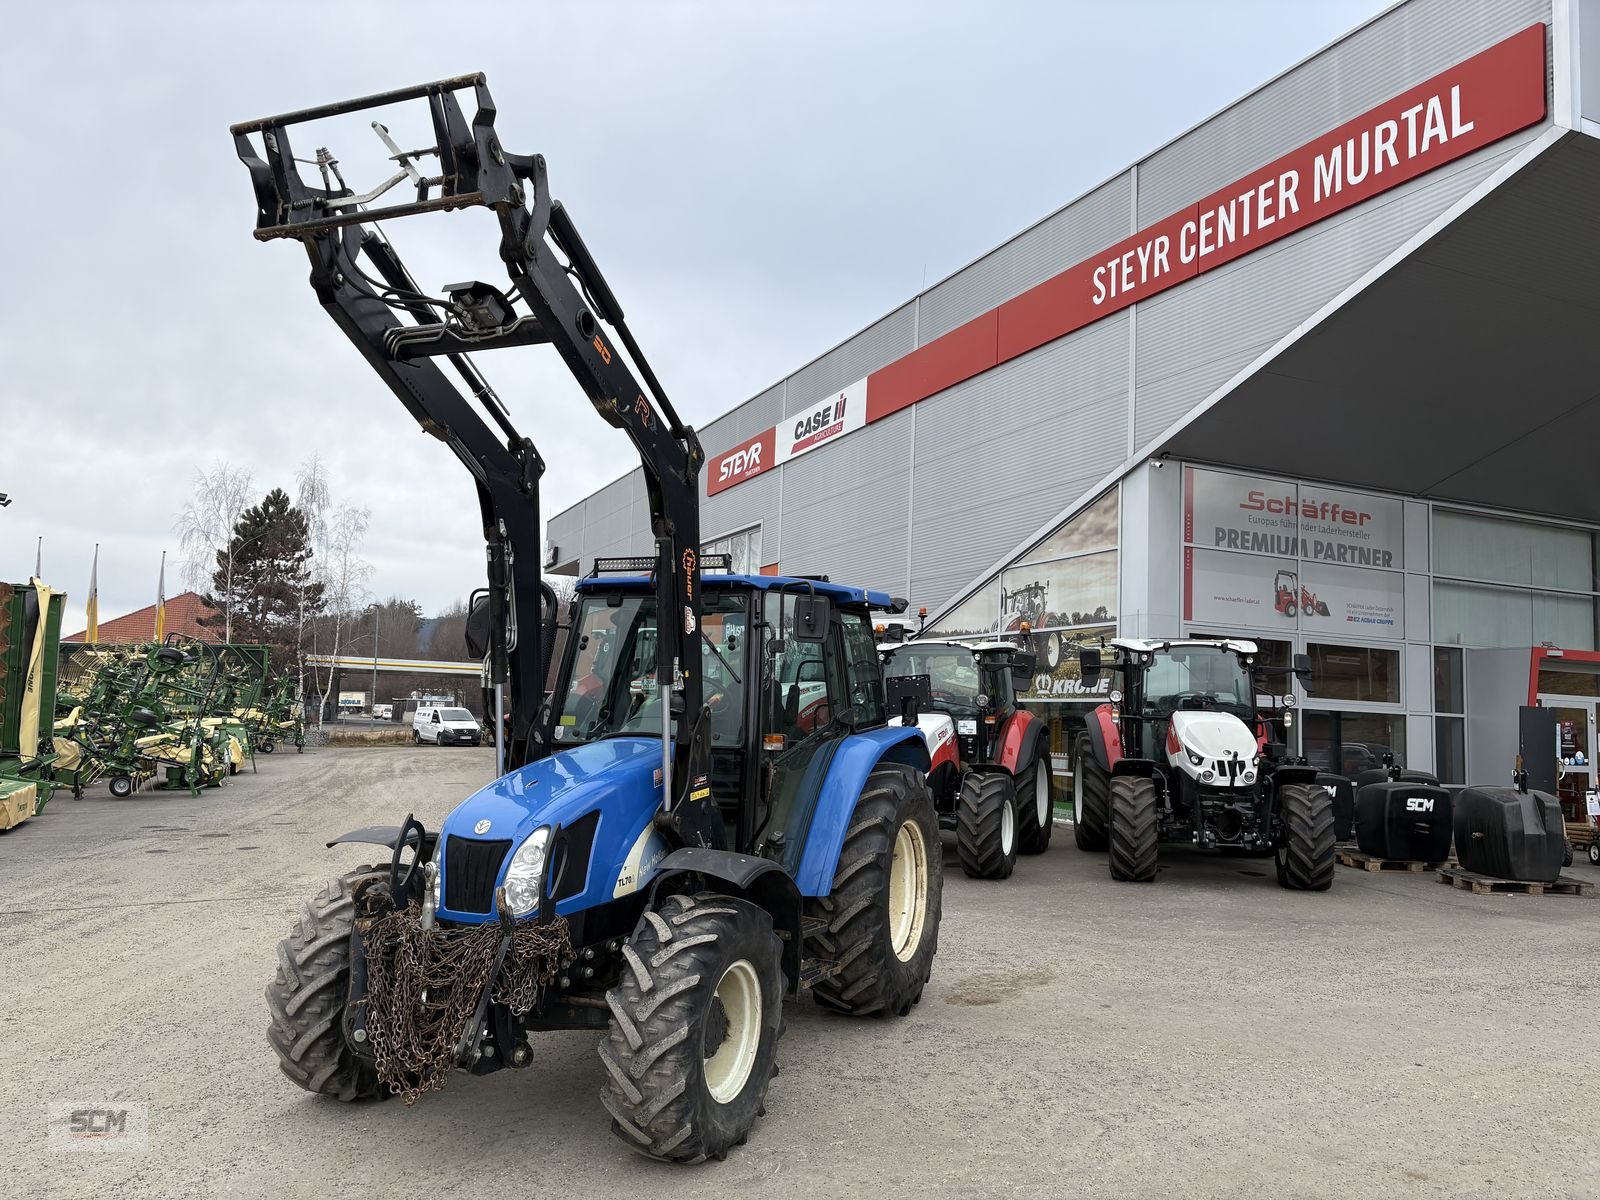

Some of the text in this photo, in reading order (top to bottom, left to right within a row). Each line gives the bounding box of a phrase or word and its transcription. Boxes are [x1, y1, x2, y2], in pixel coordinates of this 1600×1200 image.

[1091, 84, 1475, 306] STEYR CENTER MURTAL
[794, 405, 832, 440] CASE
[718, 442, 763, 482] STEYR
[1239, 490, 1372, 526] Schäffer
[1247, 514, 1371, 541] Europas führnder Laderhersteller
[1214, 526, 1309, 558] PREMIUM
[1313, 540, 1393, 568] PARTNER
[1405, 797, 1435, 812] SCM
